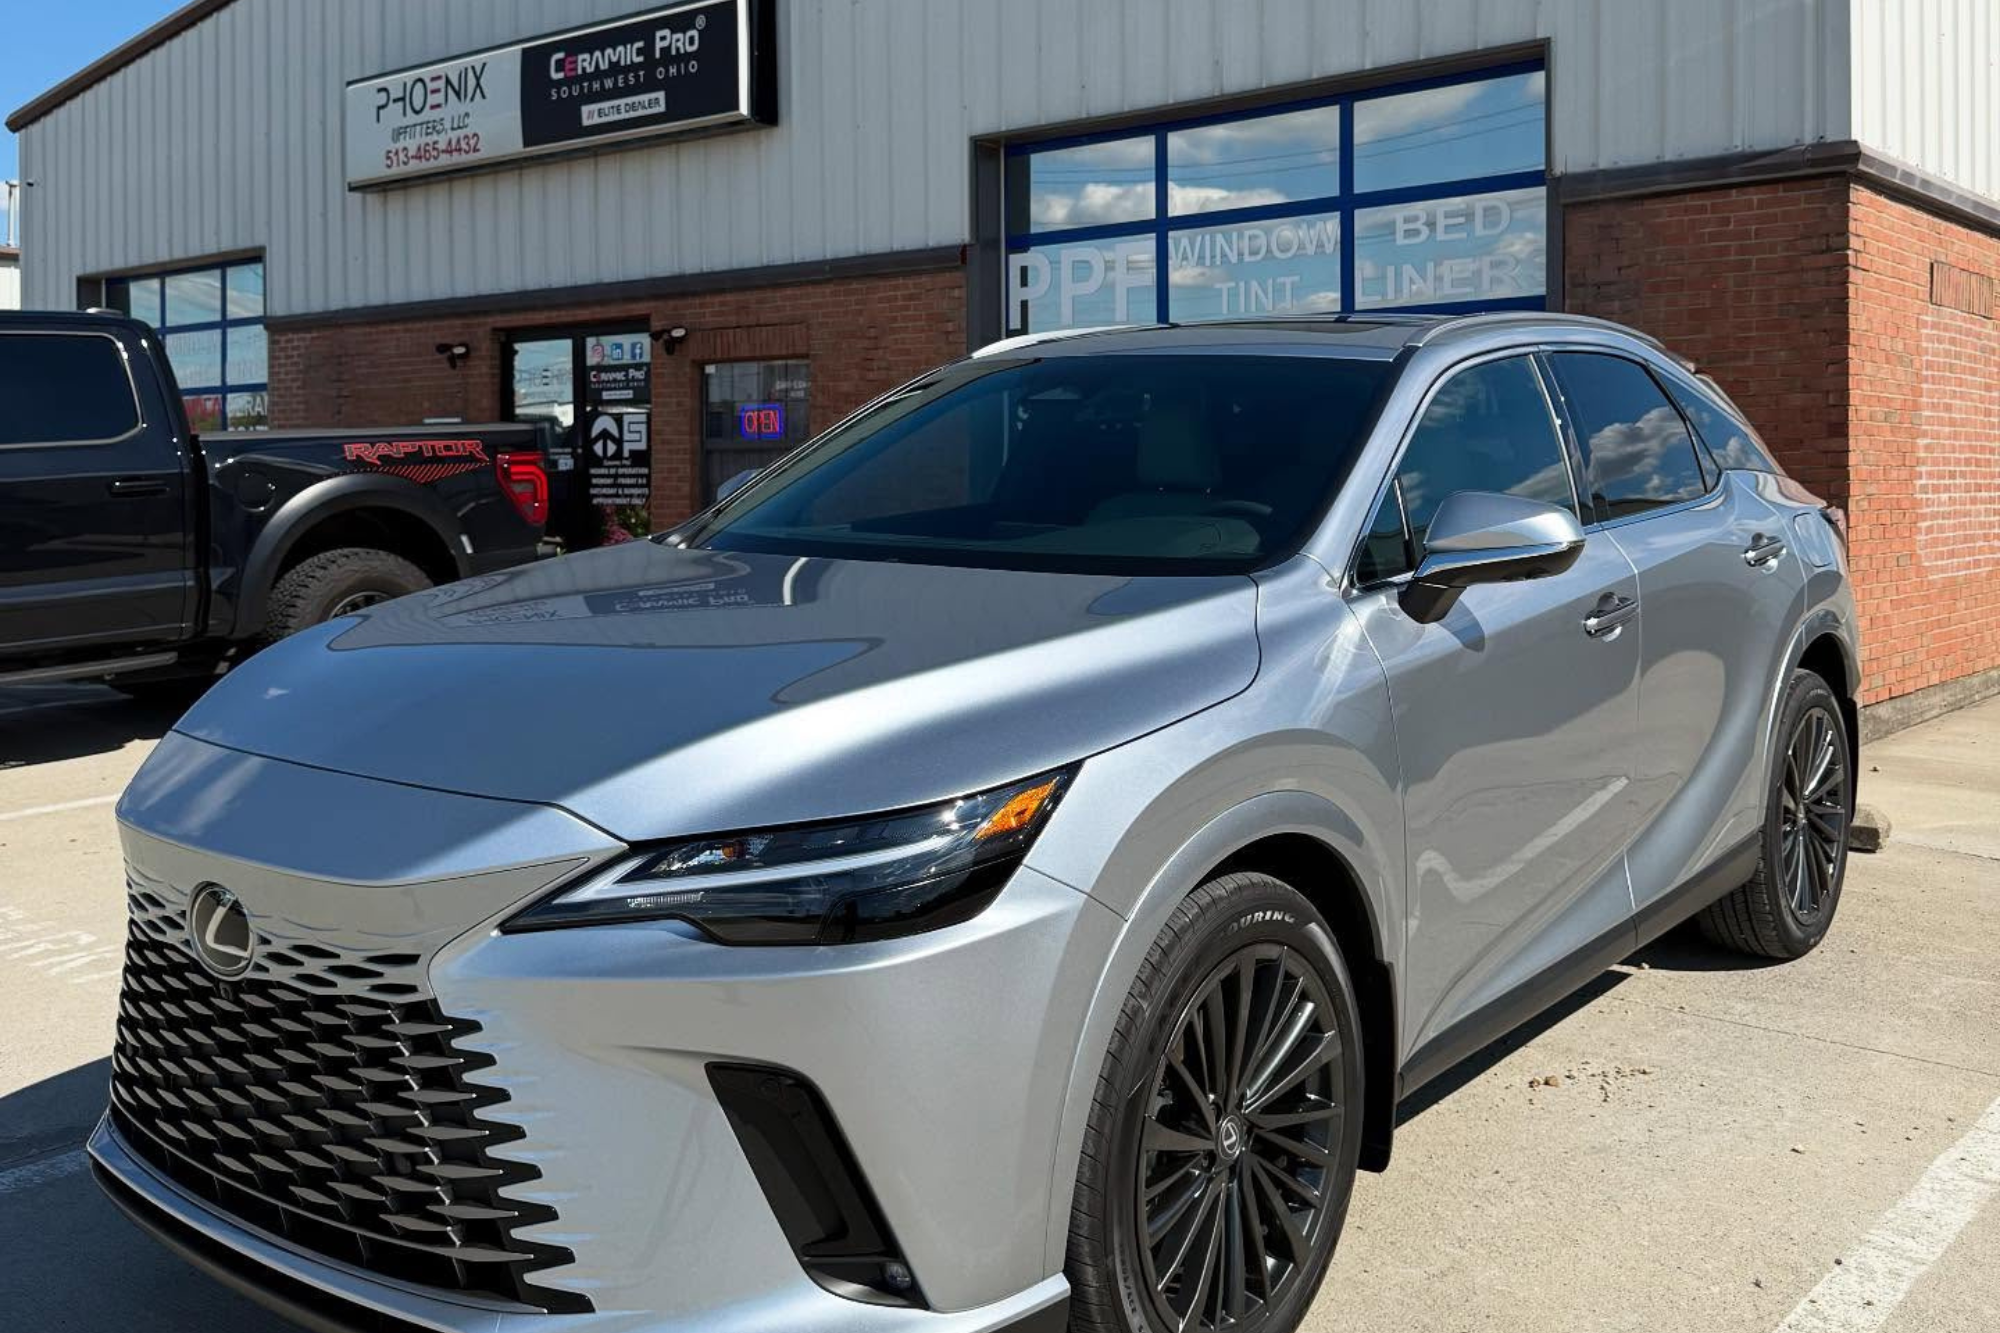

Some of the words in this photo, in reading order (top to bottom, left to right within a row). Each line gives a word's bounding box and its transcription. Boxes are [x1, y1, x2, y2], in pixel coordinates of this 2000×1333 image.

[550, 40, 645, 80] CERAMIC
[376, 62, 487, 123] PHOENIX
[551, 71, 645, 100] SOUTHWEST
[656, 61, 698, 79] OHIO
[450, 111, 470, 131] LLC
[597, 104, 622, 118] ELITE
[624, 98, 661, 114] DEALER
[385, 133, 481, 169] 513-465-4432
[1395, 200, 1511, 246] BED
[1168, 221, 1339, 267] WINDOW
[1008, 240, 1156, 330] PPF
[1214, 276, 1300, 314] TINT
[1356, 255, 1524, 302] LINER
[744, 409, 779, 433] OPEN
[344, 440, 489, 465] RAPTOR
